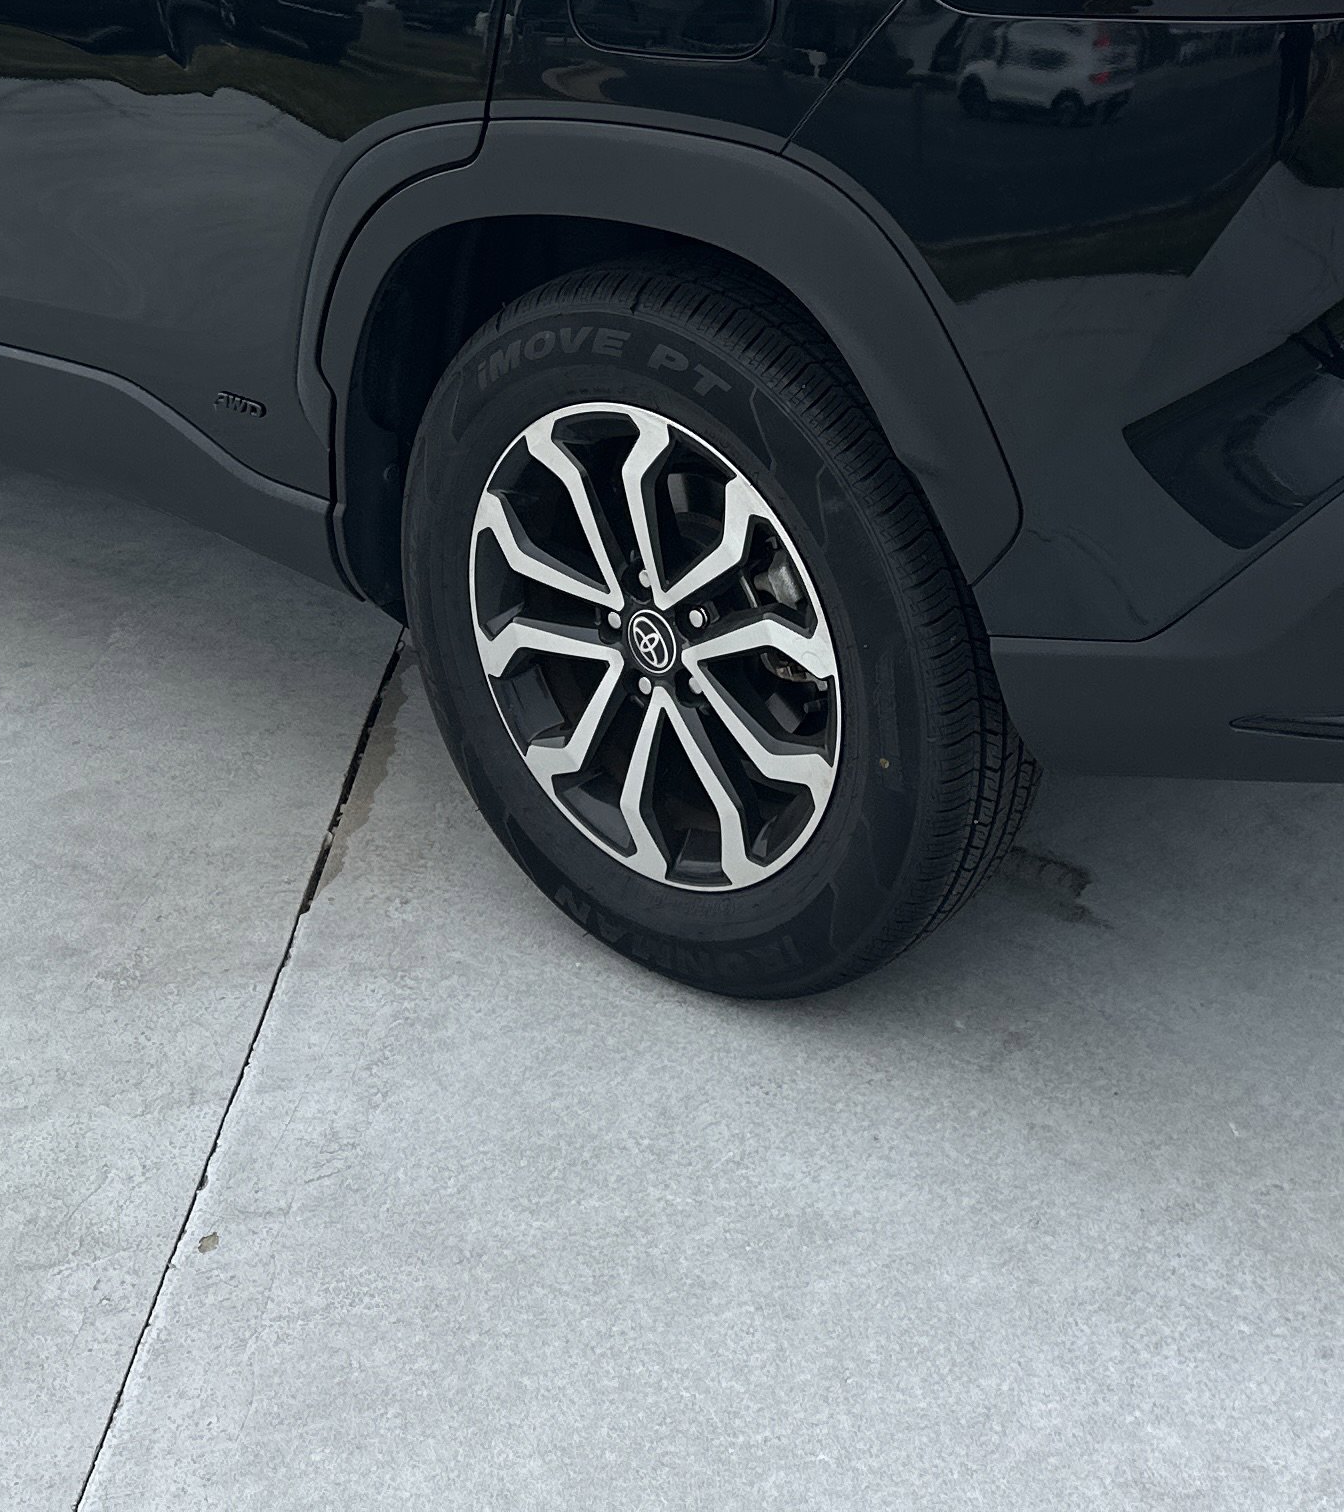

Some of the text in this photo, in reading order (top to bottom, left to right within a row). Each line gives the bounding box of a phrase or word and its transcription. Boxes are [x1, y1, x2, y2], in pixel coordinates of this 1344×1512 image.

[476, 326, 733, 397] iMOVE PT
[212, 390, 267, 419] AWD
